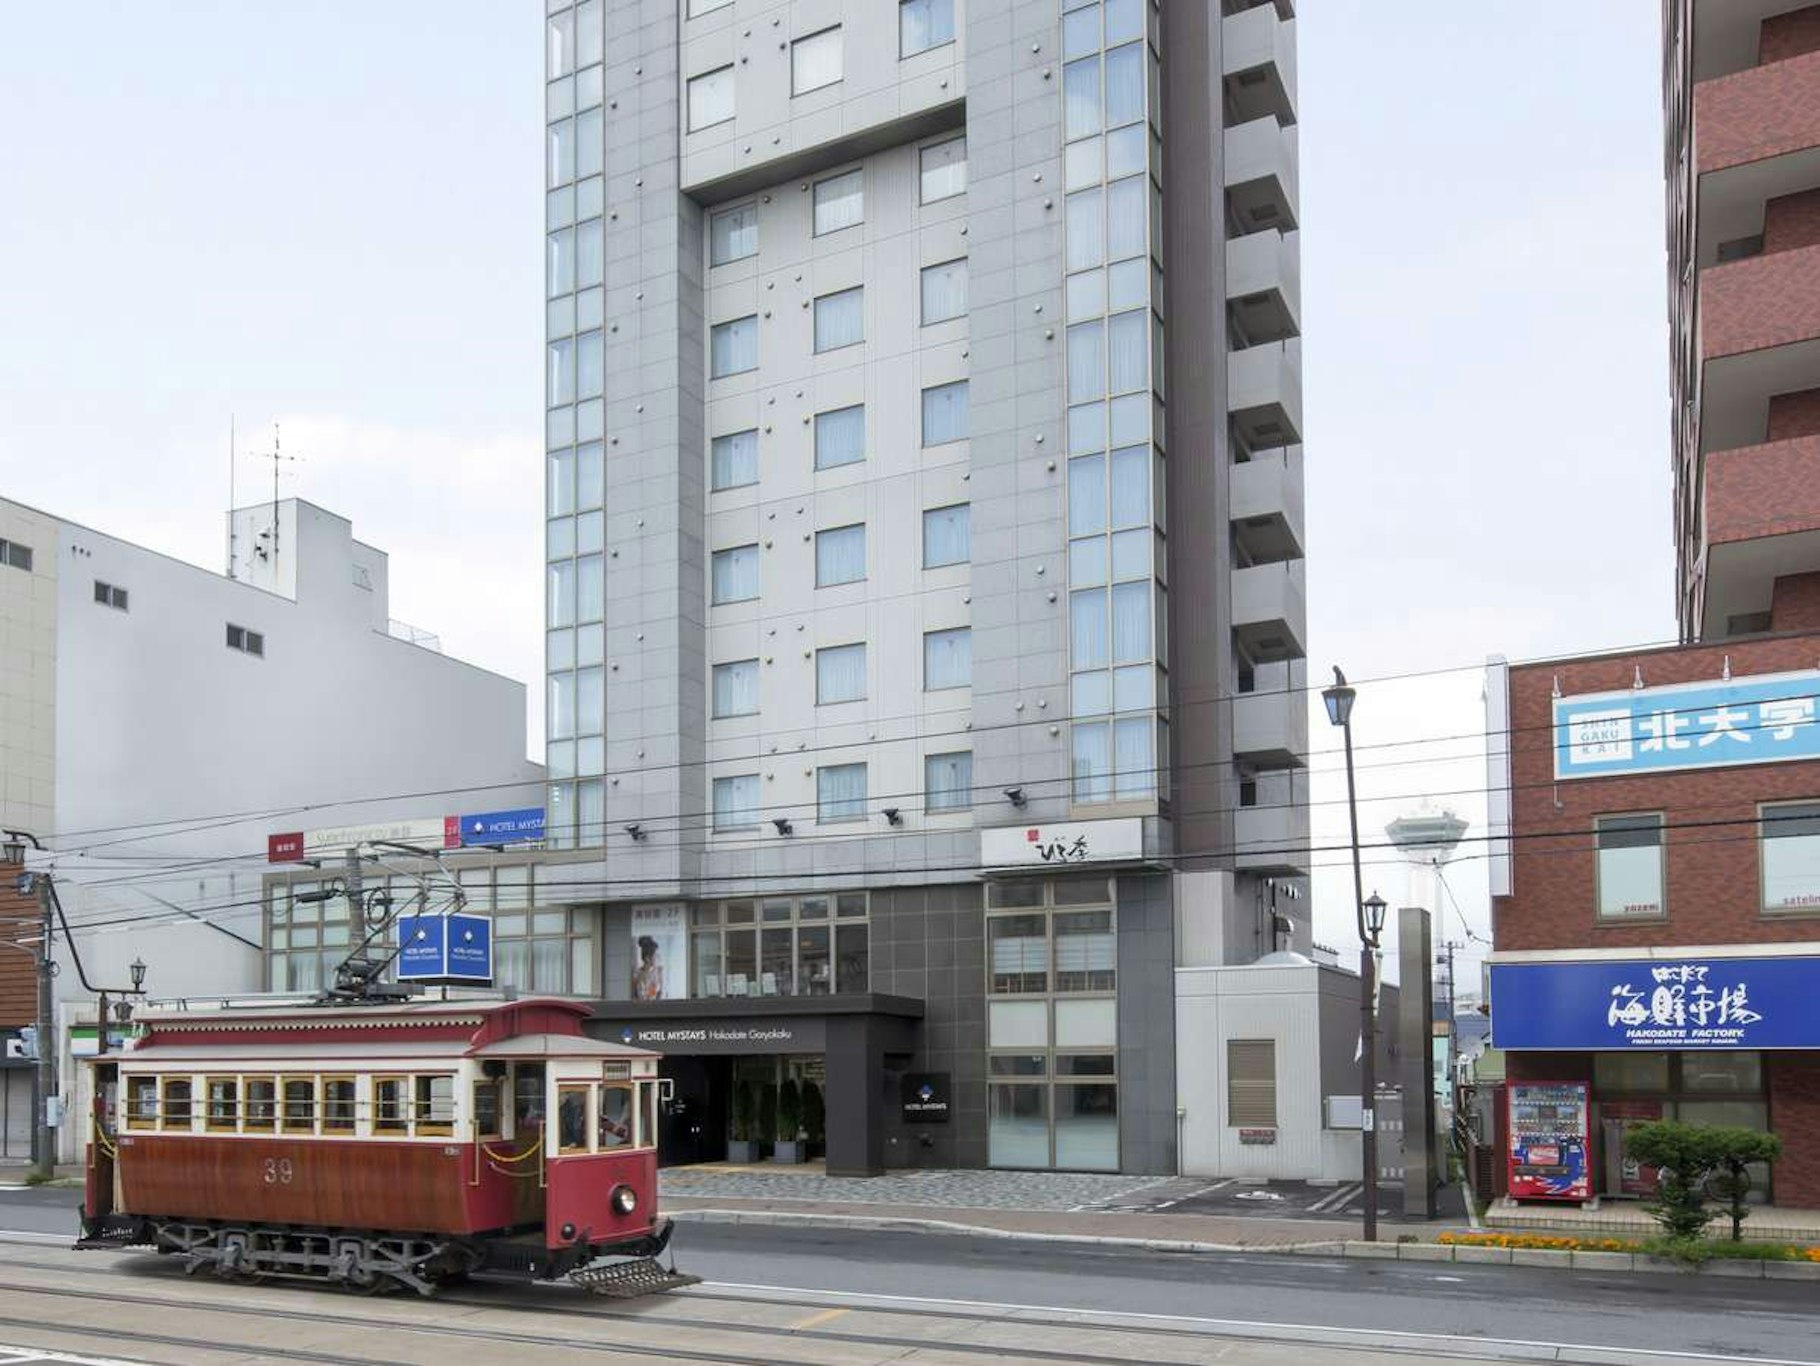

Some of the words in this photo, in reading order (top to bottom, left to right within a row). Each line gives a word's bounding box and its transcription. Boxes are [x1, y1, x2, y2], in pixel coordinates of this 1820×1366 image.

[1638, 698, 1816, 752] 北大学
[1581, 729, 1619, 741] GAKU
[638, 1030, 665, 1041] HOTEL
[667, 1029, 706, 1041] MYSTAYS
[1626, 1029, 1686, 1038] HAKODATE
[264, 1157, 293, 1184] 39
